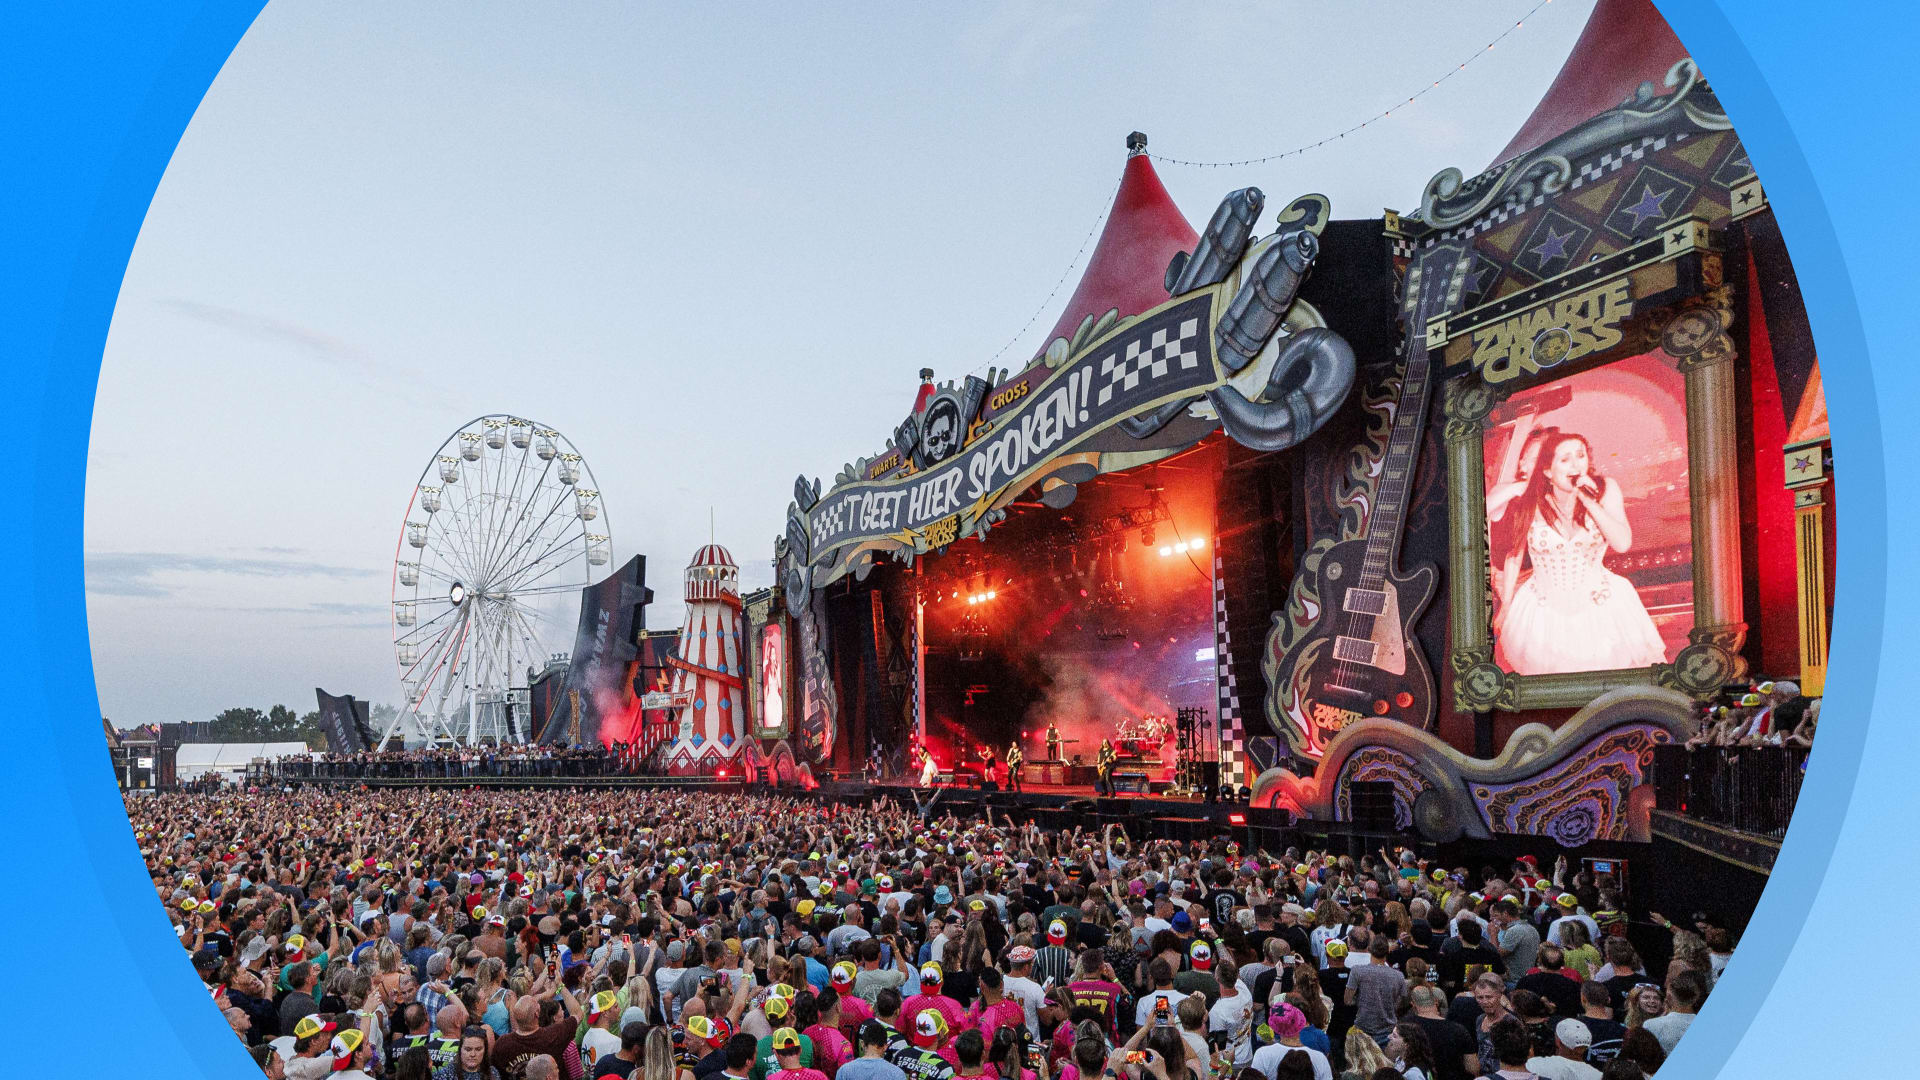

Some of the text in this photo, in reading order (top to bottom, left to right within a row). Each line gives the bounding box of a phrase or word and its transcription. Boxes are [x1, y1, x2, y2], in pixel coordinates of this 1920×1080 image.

[1472, 277, 1633, 368] ZWARTE
[870, 380, 1028, 480] ZWARTE CROSS
[844, 365, 1093, 532] 'T GEET HIER SPOKEN!
[924, 514, 958, 541] ZWARTE
[927, 528, 955, 551] CROSS
[1313, 703, 1363, 722] ZWARTE
[896, 1060, 940, 1078] SPOKEN!
